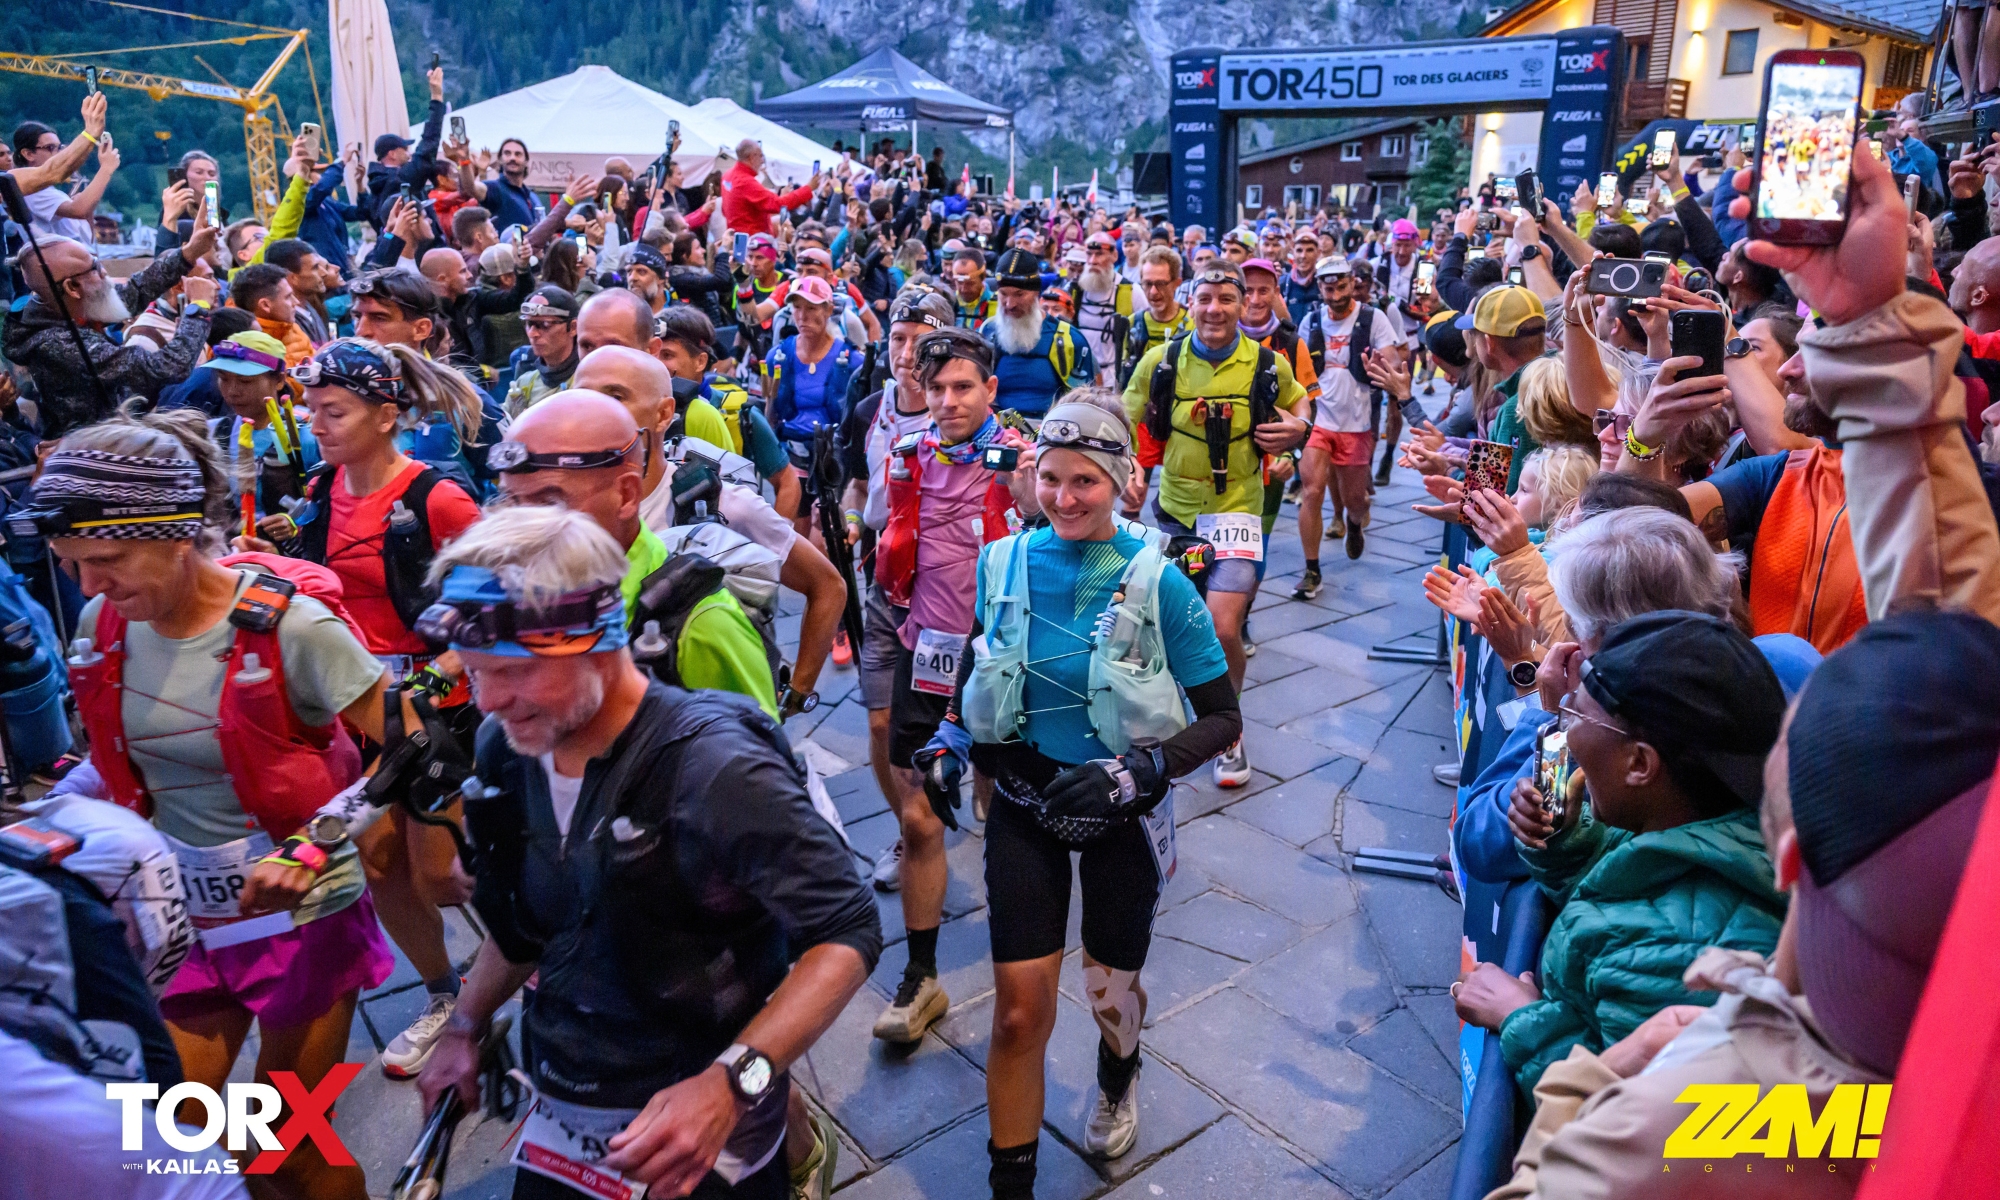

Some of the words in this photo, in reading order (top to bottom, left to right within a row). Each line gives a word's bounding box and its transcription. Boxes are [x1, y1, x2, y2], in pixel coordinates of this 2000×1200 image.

[1559, 49, 1610, 73] TORX
[1175, 67, 1216, 89] TORX
[1393, 75, 1418, 86] TOR
[1420, 73, 1444, 84] DES
[1447, 69, 1509, 83] GLACIERS
[862, 106, 896, 118] FUGA
[1552, 110, 1592, 122] FUGA
[1175, 122, 1207, 133] FUGA
[103, 504, 178, 516] NITECORE
[1212, 527, 1250, 543] 4170
